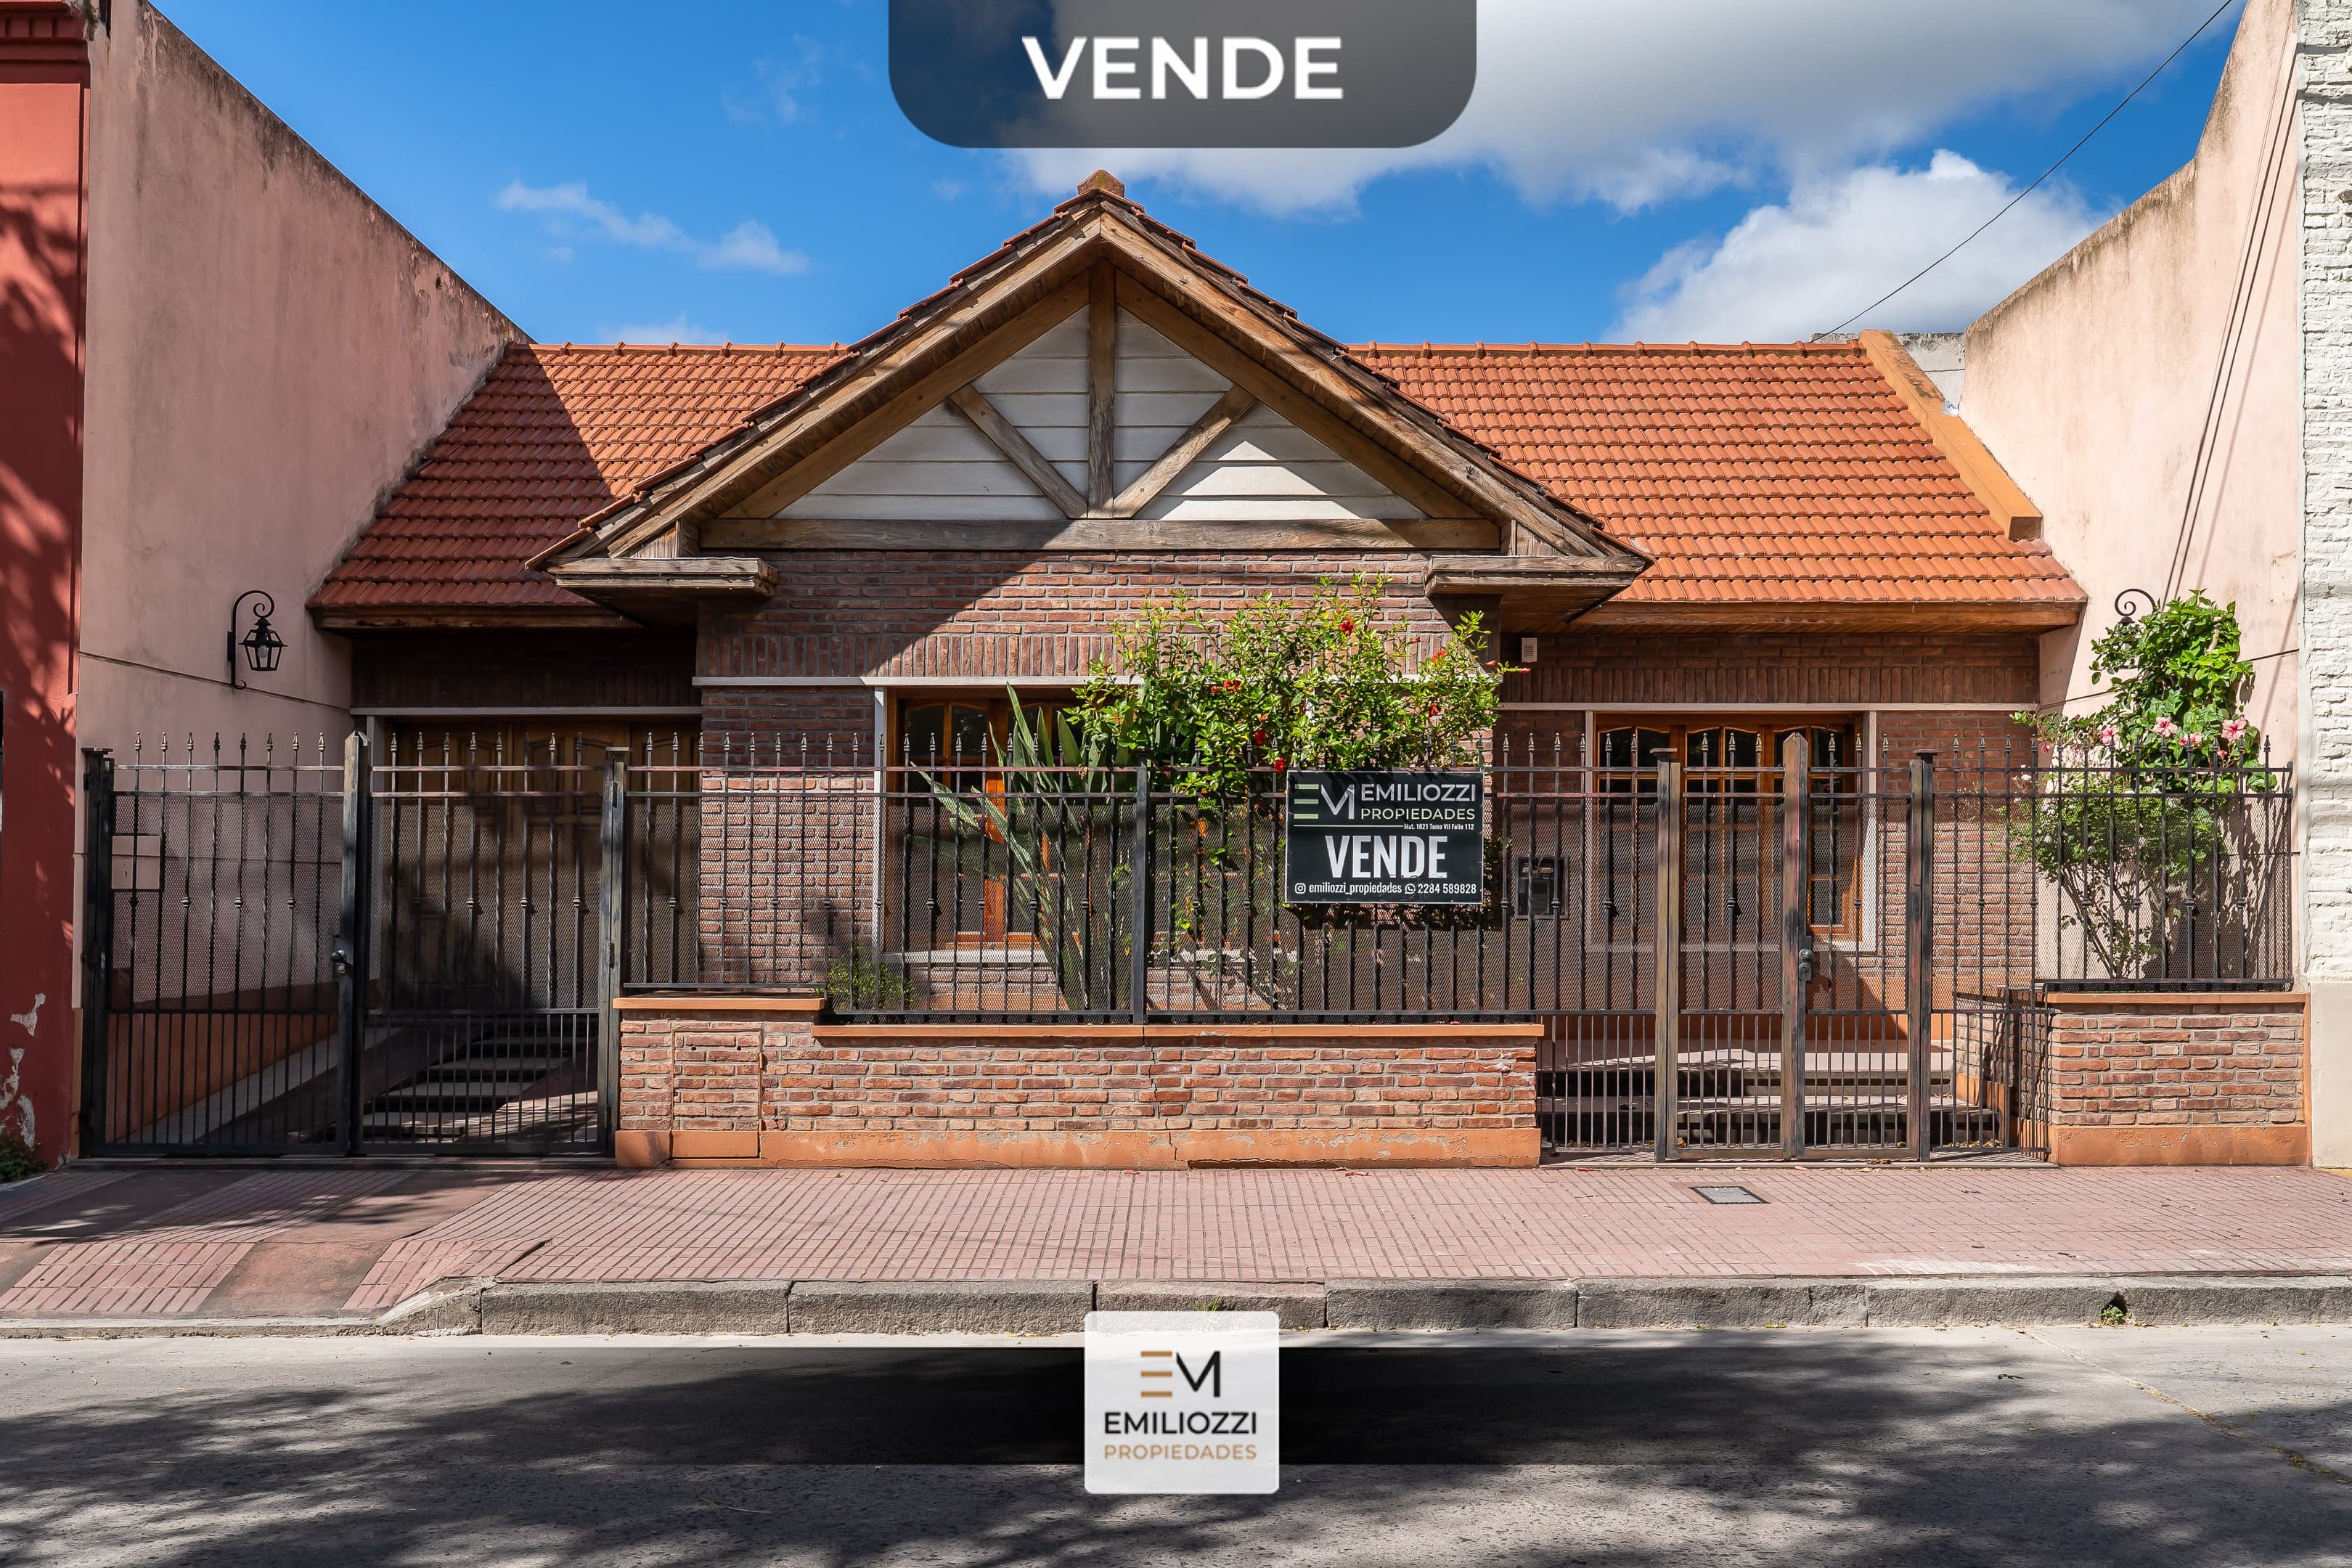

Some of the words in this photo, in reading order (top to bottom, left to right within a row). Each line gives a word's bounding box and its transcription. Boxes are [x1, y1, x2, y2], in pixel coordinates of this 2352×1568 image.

[1294, 783, 1355, 820] EM
[1360, 783, 1476, 802] EMILIOZZI
[1360, 808, 1475, 820] PROPIEDADES
[1325, 835, 1448, 879] VENDE
[1309, 881, 1402, 896] emiliozzi_propiedades
[1417, 883, 1441, 894] 2284
[1442, 883, 1477, 894] 589828
